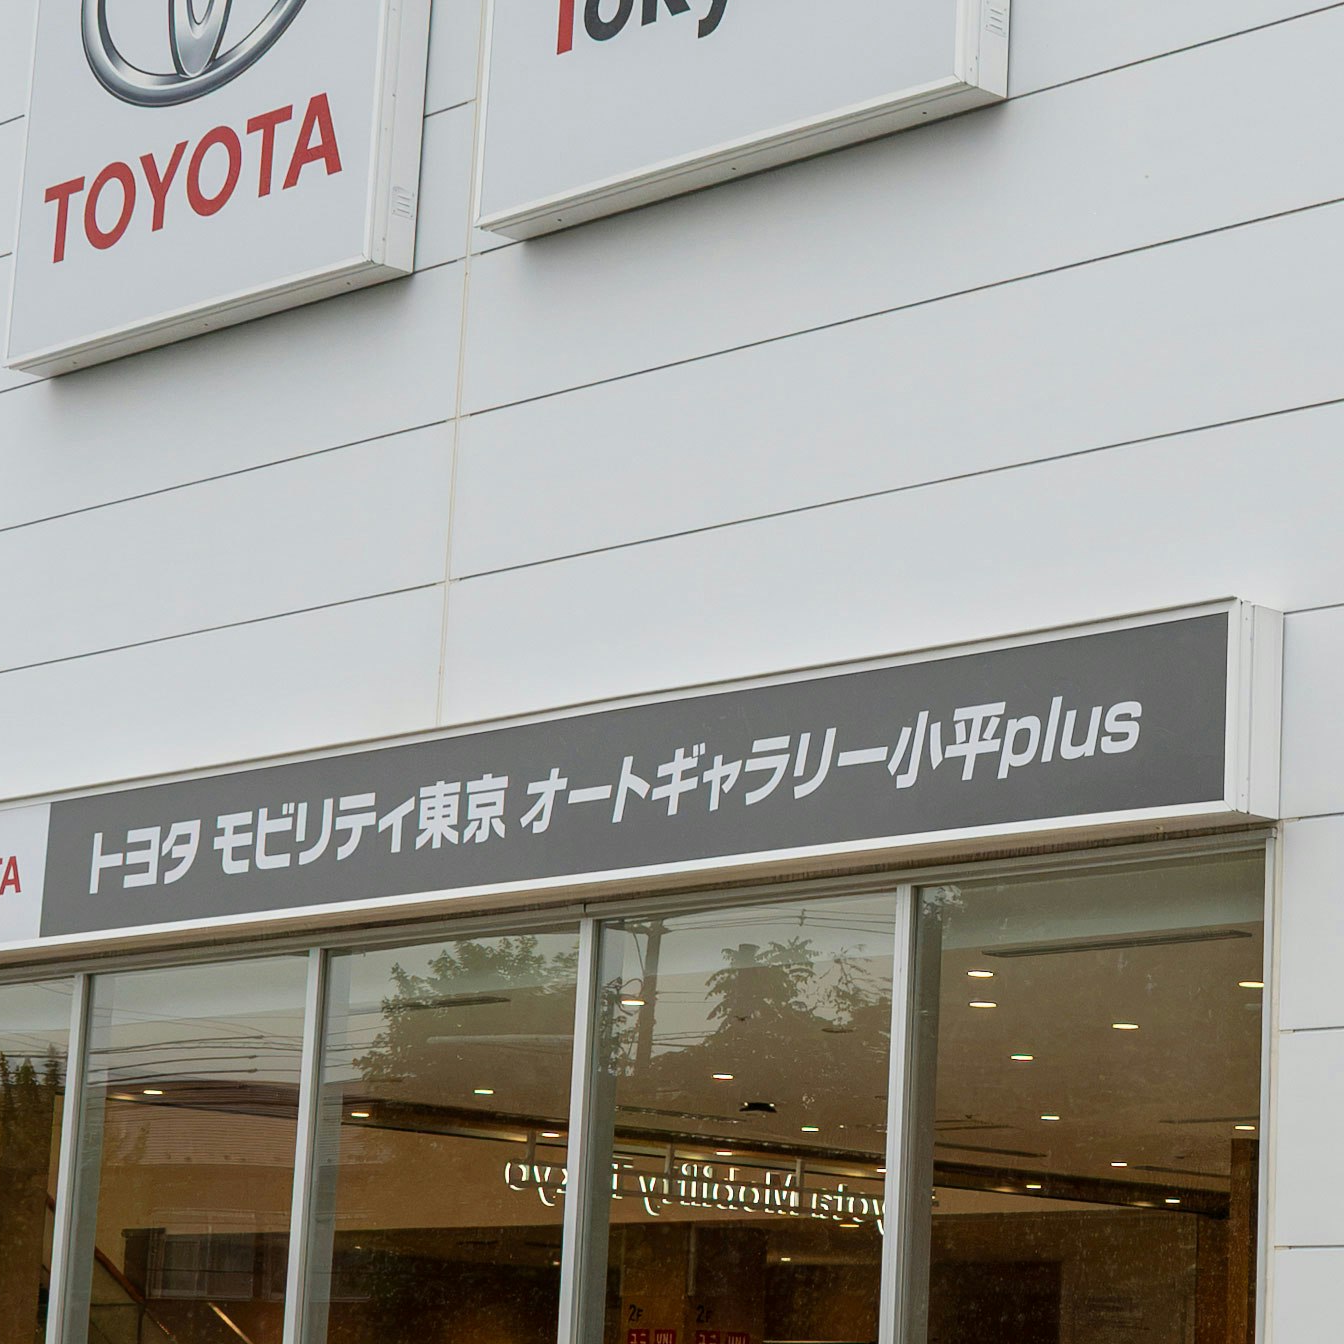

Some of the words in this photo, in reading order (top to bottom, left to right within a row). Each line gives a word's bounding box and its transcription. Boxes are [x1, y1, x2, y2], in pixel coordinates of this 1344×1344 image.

[44, 92, 343, 264] TOYOTA
[89, 818, 202, 894] トヨタ
[212, 773, 509, 876] モビリティ東京
[628, 1304, 644, 1322] 2F
[696, 1305, 714, 1323] 2F
[656, 1333, 673, 1344] UNI
